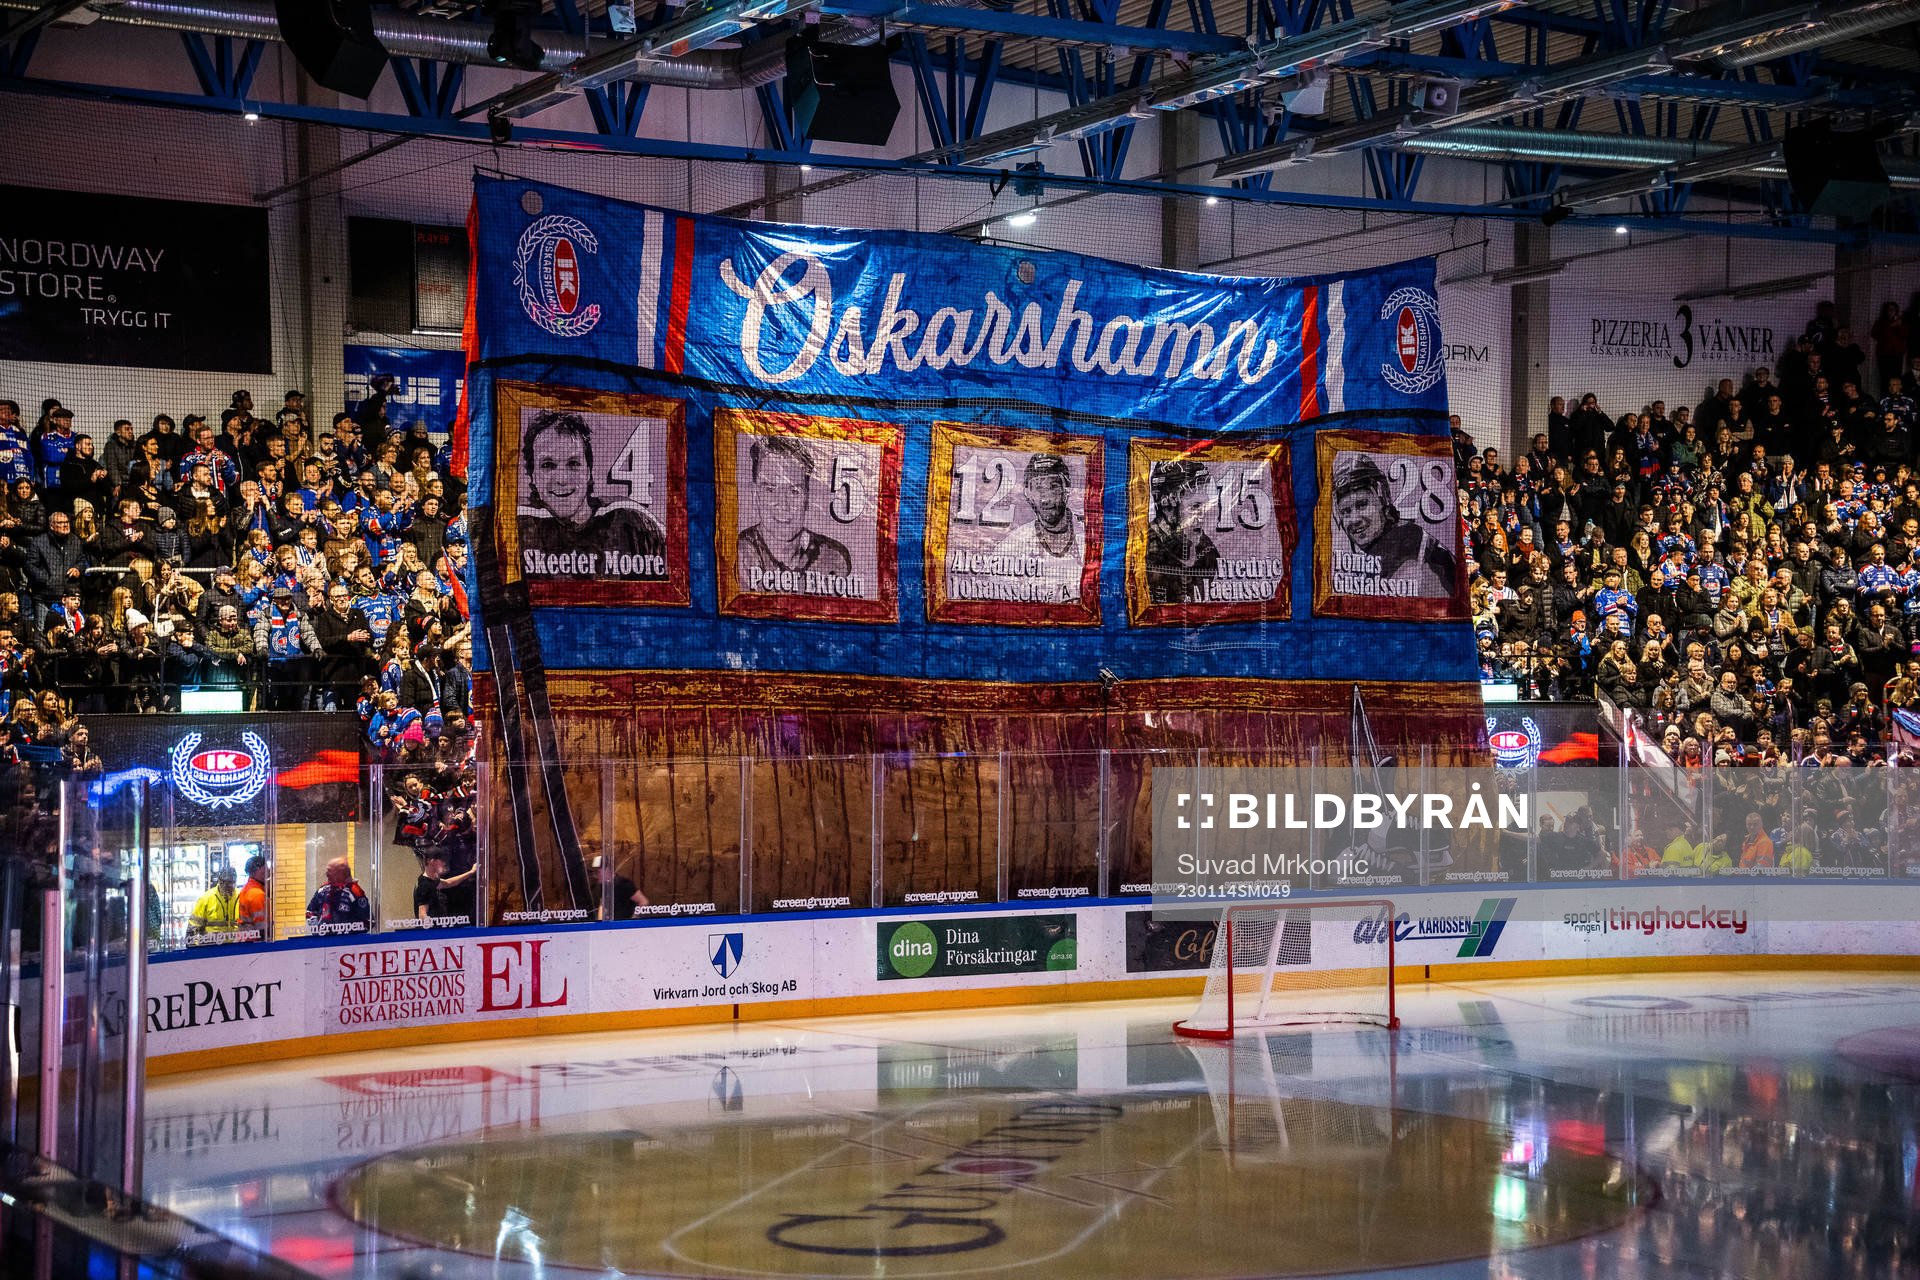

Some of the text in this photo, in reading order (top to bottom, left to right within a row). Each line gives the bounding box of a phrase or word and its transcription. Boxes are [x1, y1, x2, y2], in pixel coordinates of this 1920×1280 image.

[0, 238, 164, 272] NORDWAY
[557, 258, 576, 295] IK
[80, 307, 172, 329] TRYGG IT
[719, 251, 1277, 384] Oskarshamn
[1400, 324, 1416, 355] IK
[1591, 304, 1774, 368] PIZZERIA 3 VÄNNER
[1590, 344, 1672, 359] OSKARSHAMN
[607, 420, 655, 507] 4
[830, 454, 868, 524] 5
[953, 454, 1018, 526] 12
[1388, 456, 1454, 526] 28
[1215, 468, 1268, 534] 15
[523, 549, 665, 576] Skeeter Moore
[950, 550, 1045, 577] Alexander
[1216, 556, 1283, 579] Fredric
[1333, 549, 1382, 574] Tomas
[749, 566, 801, 592] Peter
[1499, 734, 1520, 747] IK
[206, 754, 237, 770] IK
[1337, 874, 1402, 886] screengruppen
[1445, 871, 1509, 883] screengruppen
[1550, 867, 1613, 880] screengruppen
[1809, 864, 1885, 876] screengruppen
[773, 895, 850, 909] screengruppen
[905, 890, 979, 903] screengruppen
[1018, 886, 1090, 898] screengruppen
[503, 908, 588, 922] screengruppen
[634, 902, 716, 916] screengruppen
[1563, 910, 1601, 926] sport
[1610, 904, 1748, 936] tinghockey
[385, 914, 470, 929] screengruppen
[1418, 915, 1472, 935] KAROSSEN
[182, 928, 261, 945] creengruppen
[946, 928, 980, 945] Dina
[1174, 928, 1217, 962] Caf
[893, 939, 932, 957] dina
[946, 947, 1037, 966] Försäkringar
[339, 944, 465, 979] STEFAN
[476, 939, 568, 1013] EL
[339, 972, 466, 1007] ANDERSSONS
[653, 979, 797, 1001] Virkvarn Jord och Skog AB
[339, 997, 466, 1026] OSKARSHAMN
